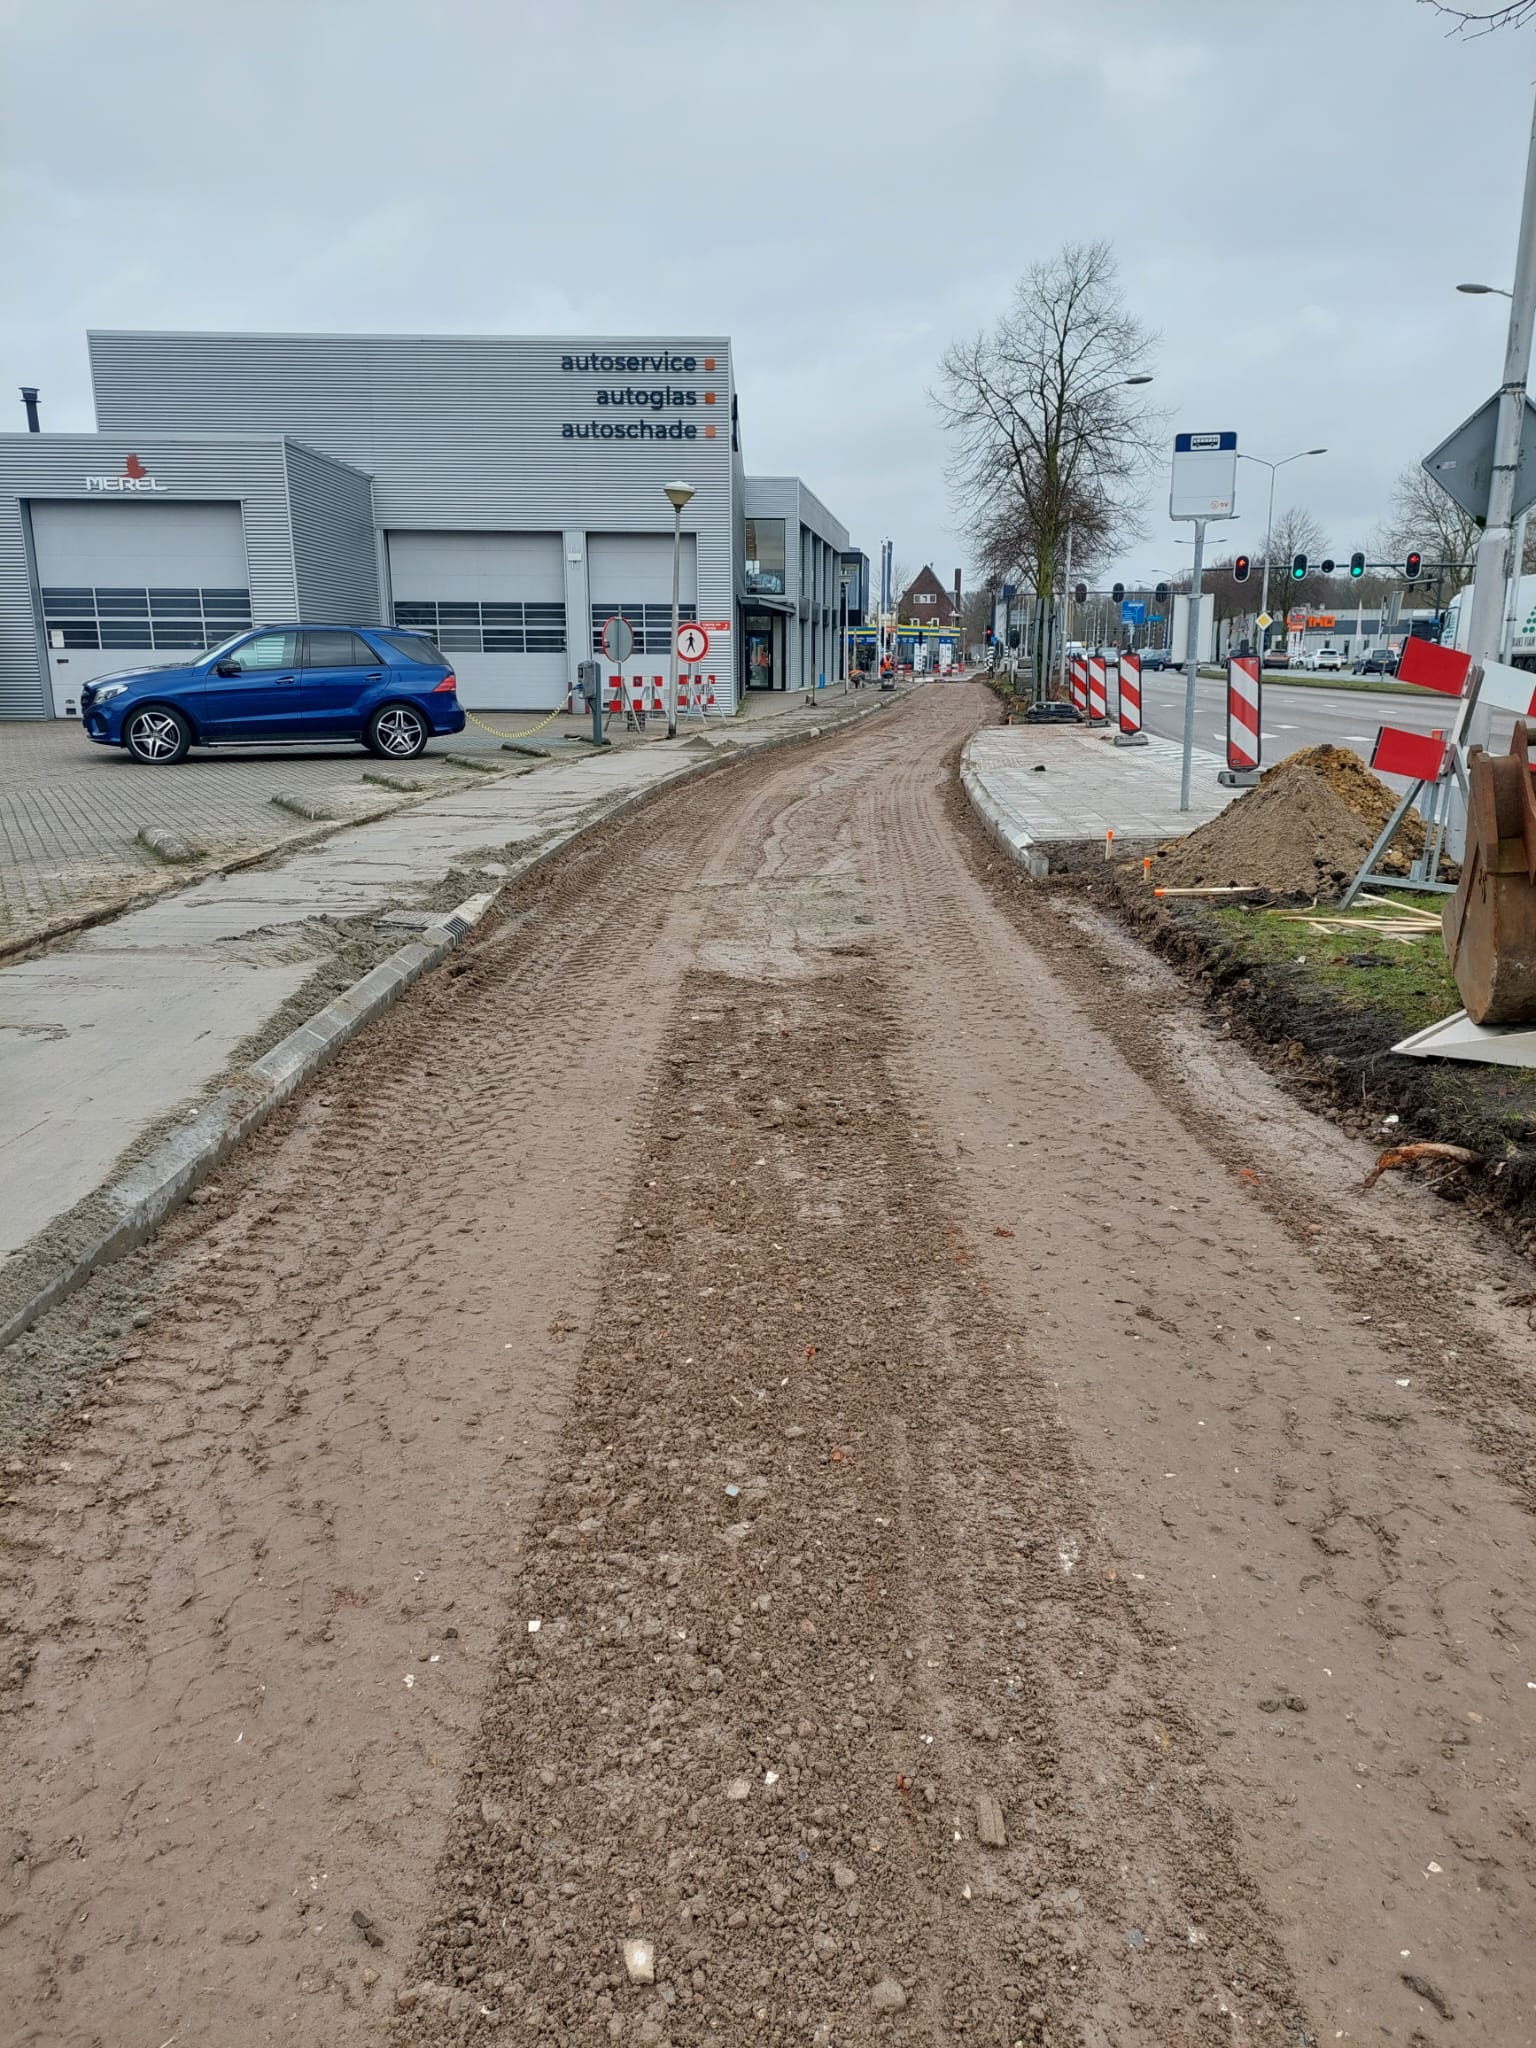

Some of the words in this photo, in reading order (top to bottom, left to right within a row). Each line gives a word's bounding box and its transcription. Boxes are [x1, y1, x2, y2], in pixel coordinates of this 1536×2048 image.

[561, 351, 697, 371] autoservice
[596, 385, 697, 410] autoglas
[561, 419, 697, 439] autoschade
[86, 476, 168, 491] MEREL
